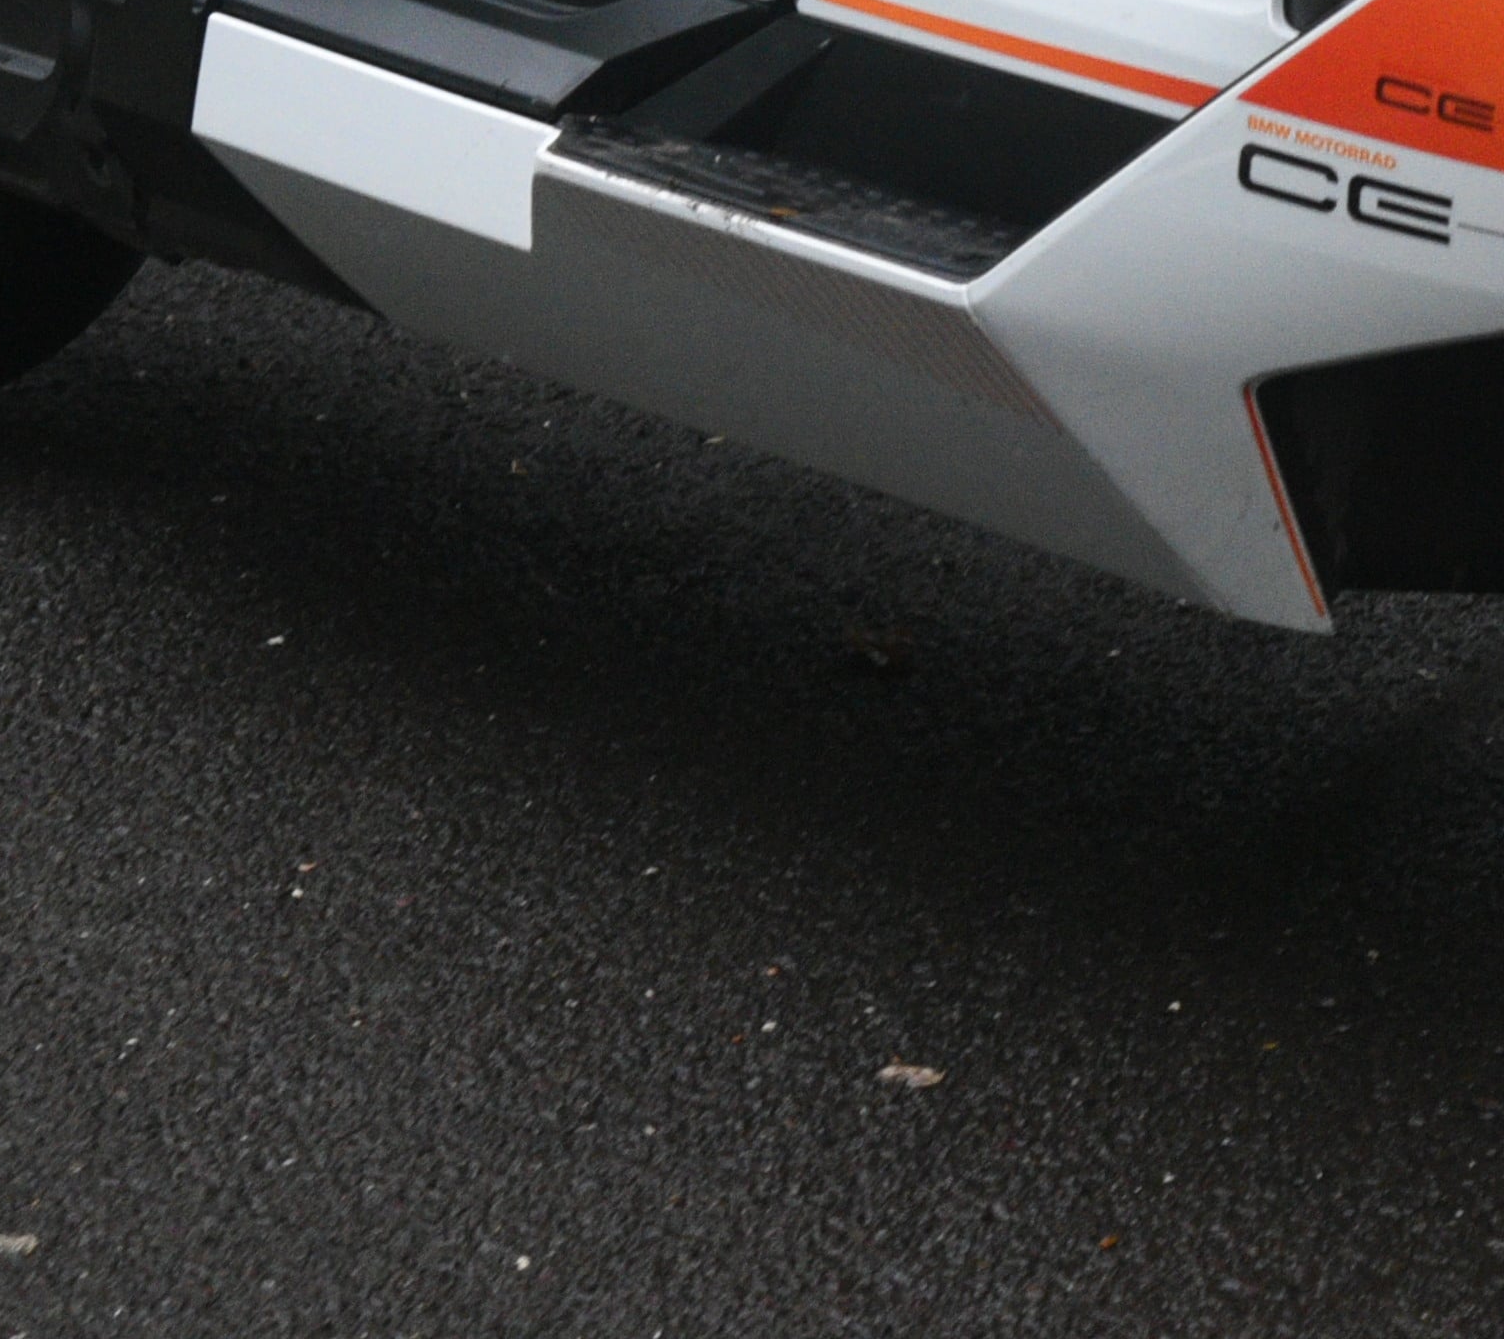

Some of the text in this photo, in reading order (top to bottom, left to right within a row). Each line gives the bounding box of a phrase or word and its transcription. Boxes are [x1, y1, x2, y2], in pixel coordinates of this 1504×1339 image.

[1375, 75, 1496, 133] CE
[1246, 113, 1398, 171] BMW MOTORRAD
[1237, 142, 1453, 247] CE
